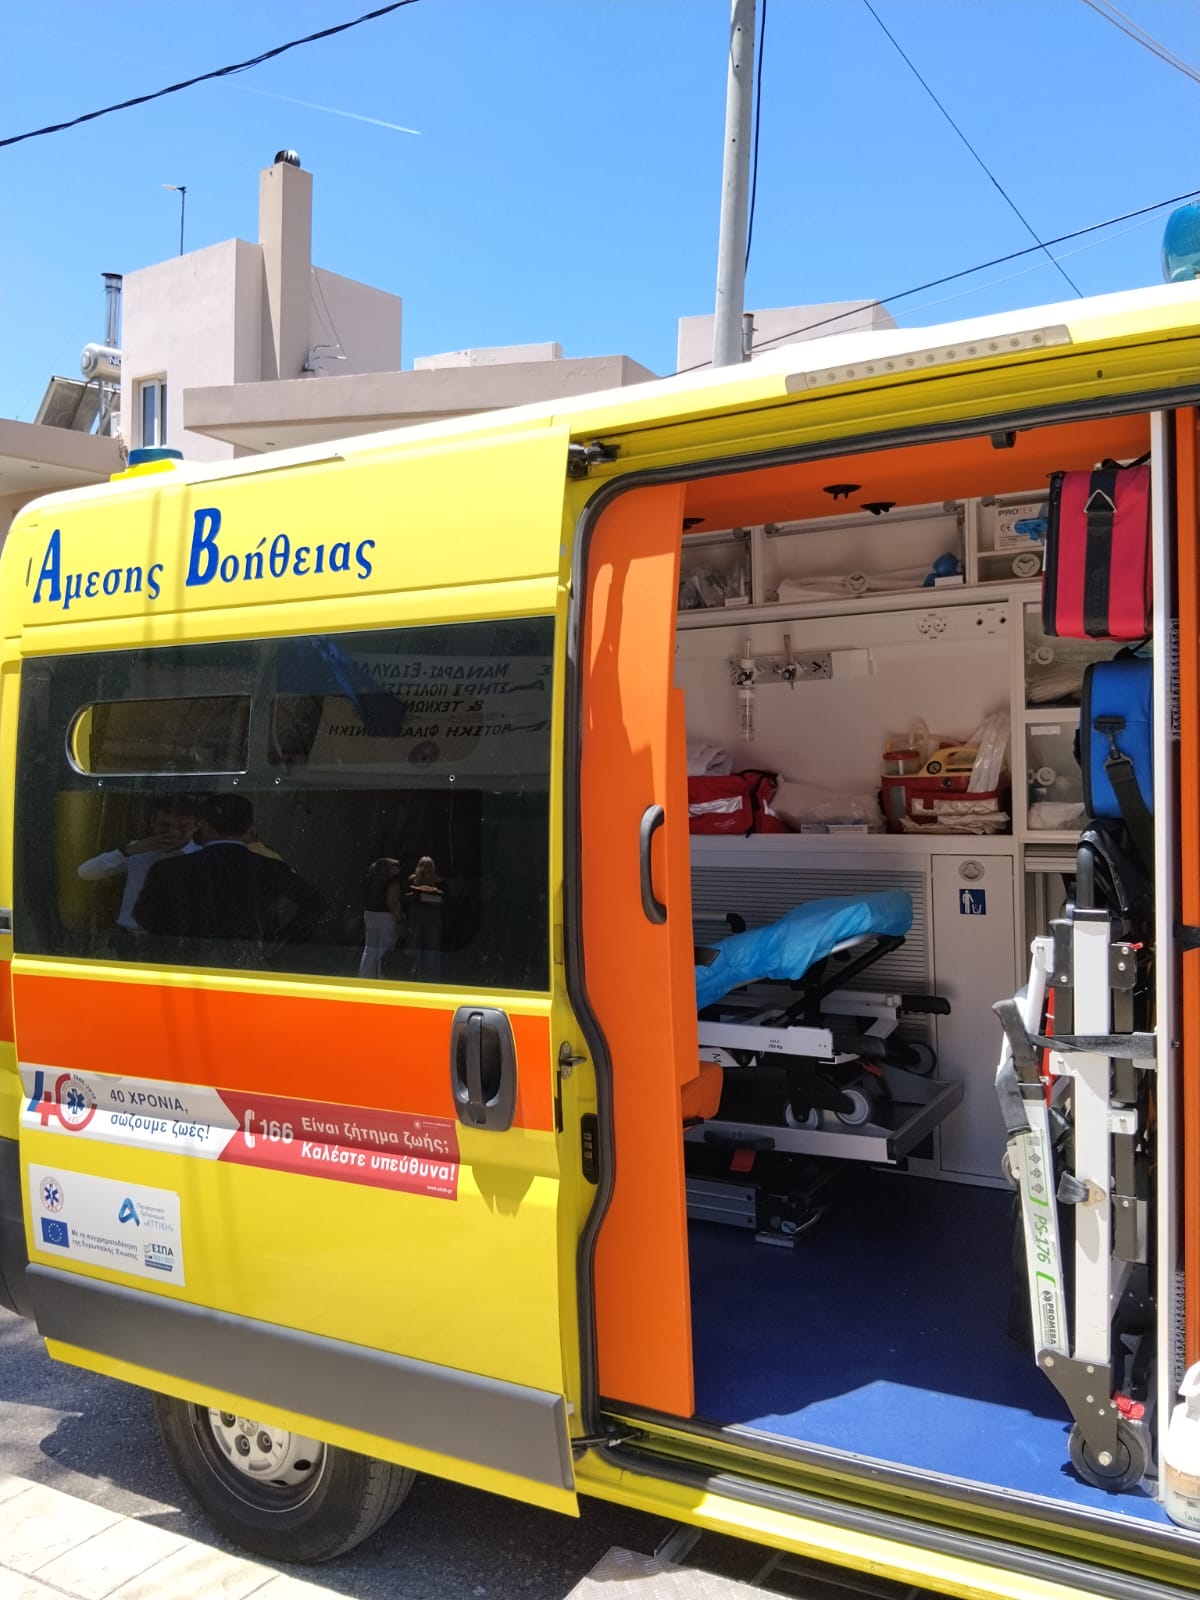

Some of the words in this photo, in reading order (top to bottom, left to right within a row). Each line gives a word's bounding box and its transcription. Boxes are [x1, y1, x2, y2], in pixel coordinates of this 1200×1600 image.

[998, 507, 1033, 517] PROTEX
[185, 507, 375, 587] Βοήθειας
[110, 1089, 125, 1104] 40
[127, 1092, 189, 1115] ΧΡΟΝΙΑ,
[110, 1111, 167, 1135] σώζουμε
[171, 1119, 211, 1142] ζωές!
[259, 1119, 294, 1145] 166
[301, 1116, 340, 1136] Είναι
[343, 1122, 399, 1145] ζήτημα
[403, 1131, 450, 1154] ζωής;
[301, 1141, 366, 1168] Καλέστε
[371, 1155, 455, 1181] υπεύθυνα!
[152, 1243, 174, 1257] ΕΣΠΑ
[1033, 1213, 1051, 1265] PS-176
[1047, 1302, 1057, 1345] PROMEBA
